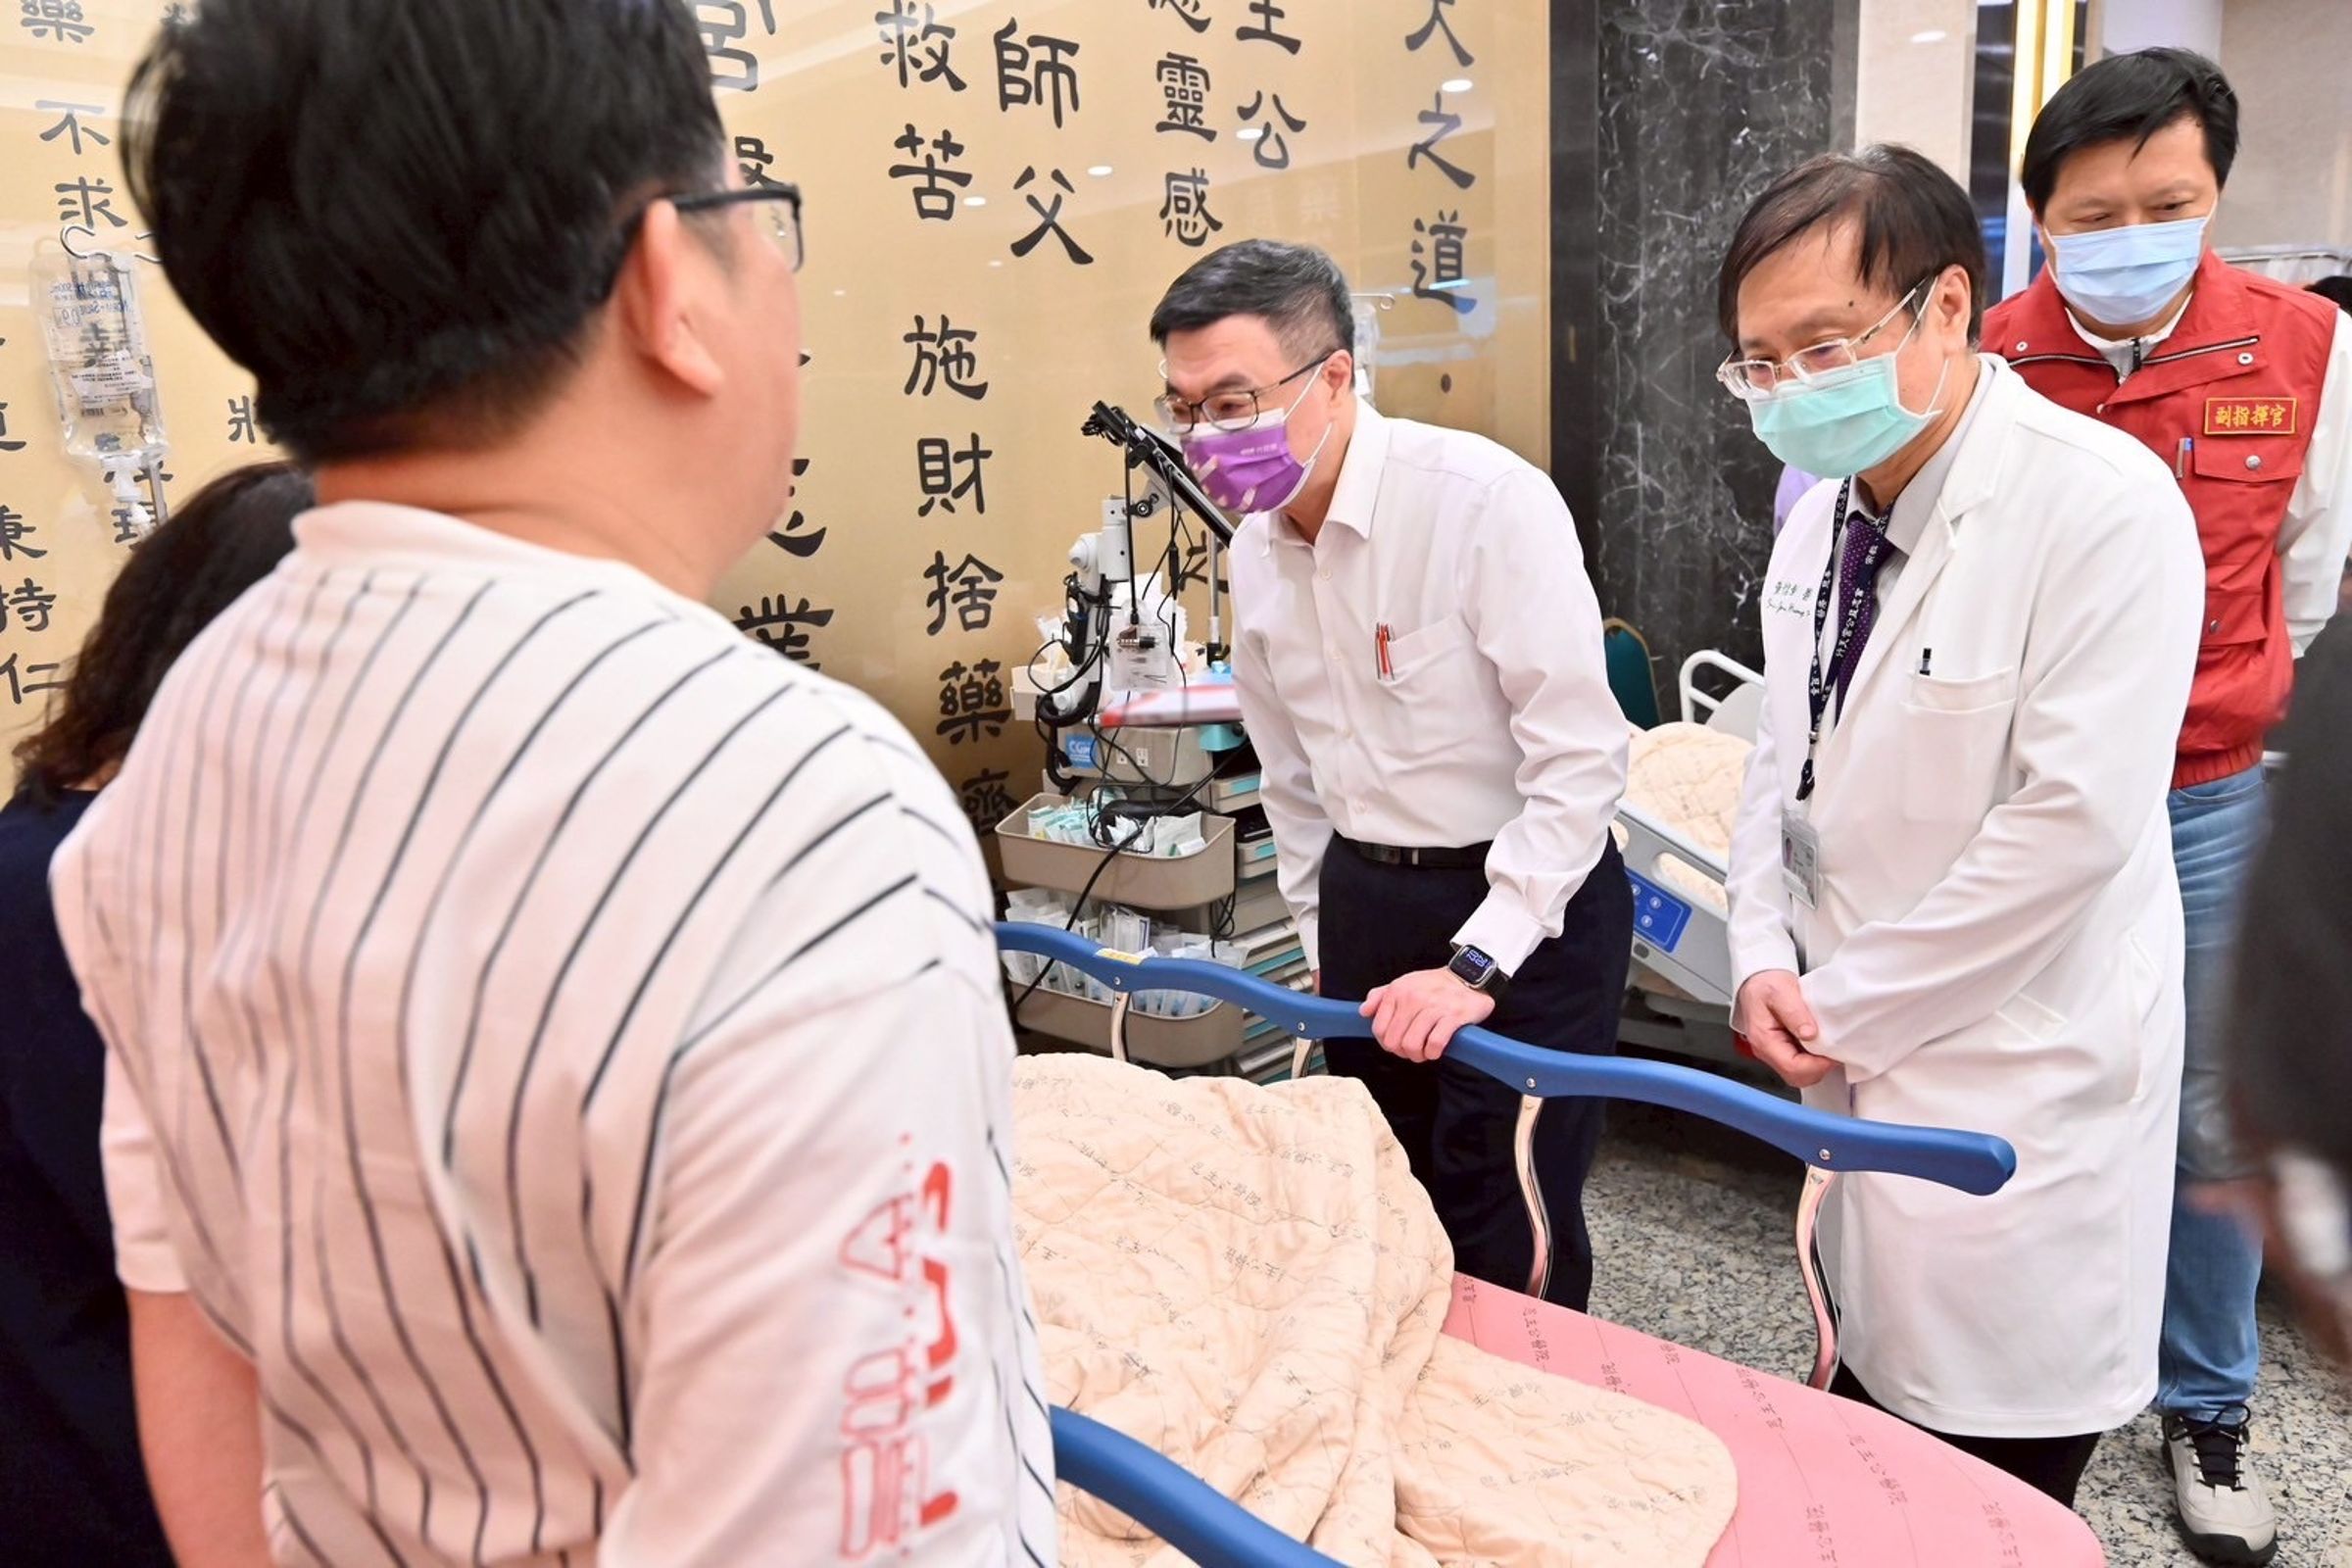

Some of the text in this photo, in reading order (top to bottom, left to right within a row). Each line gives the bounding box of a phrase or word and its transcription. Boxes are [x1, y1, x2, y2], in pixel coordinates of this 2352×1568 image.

[993, 17, 1095, 266] 師父
[2214, 404, 2286, 428] 副指揮官
